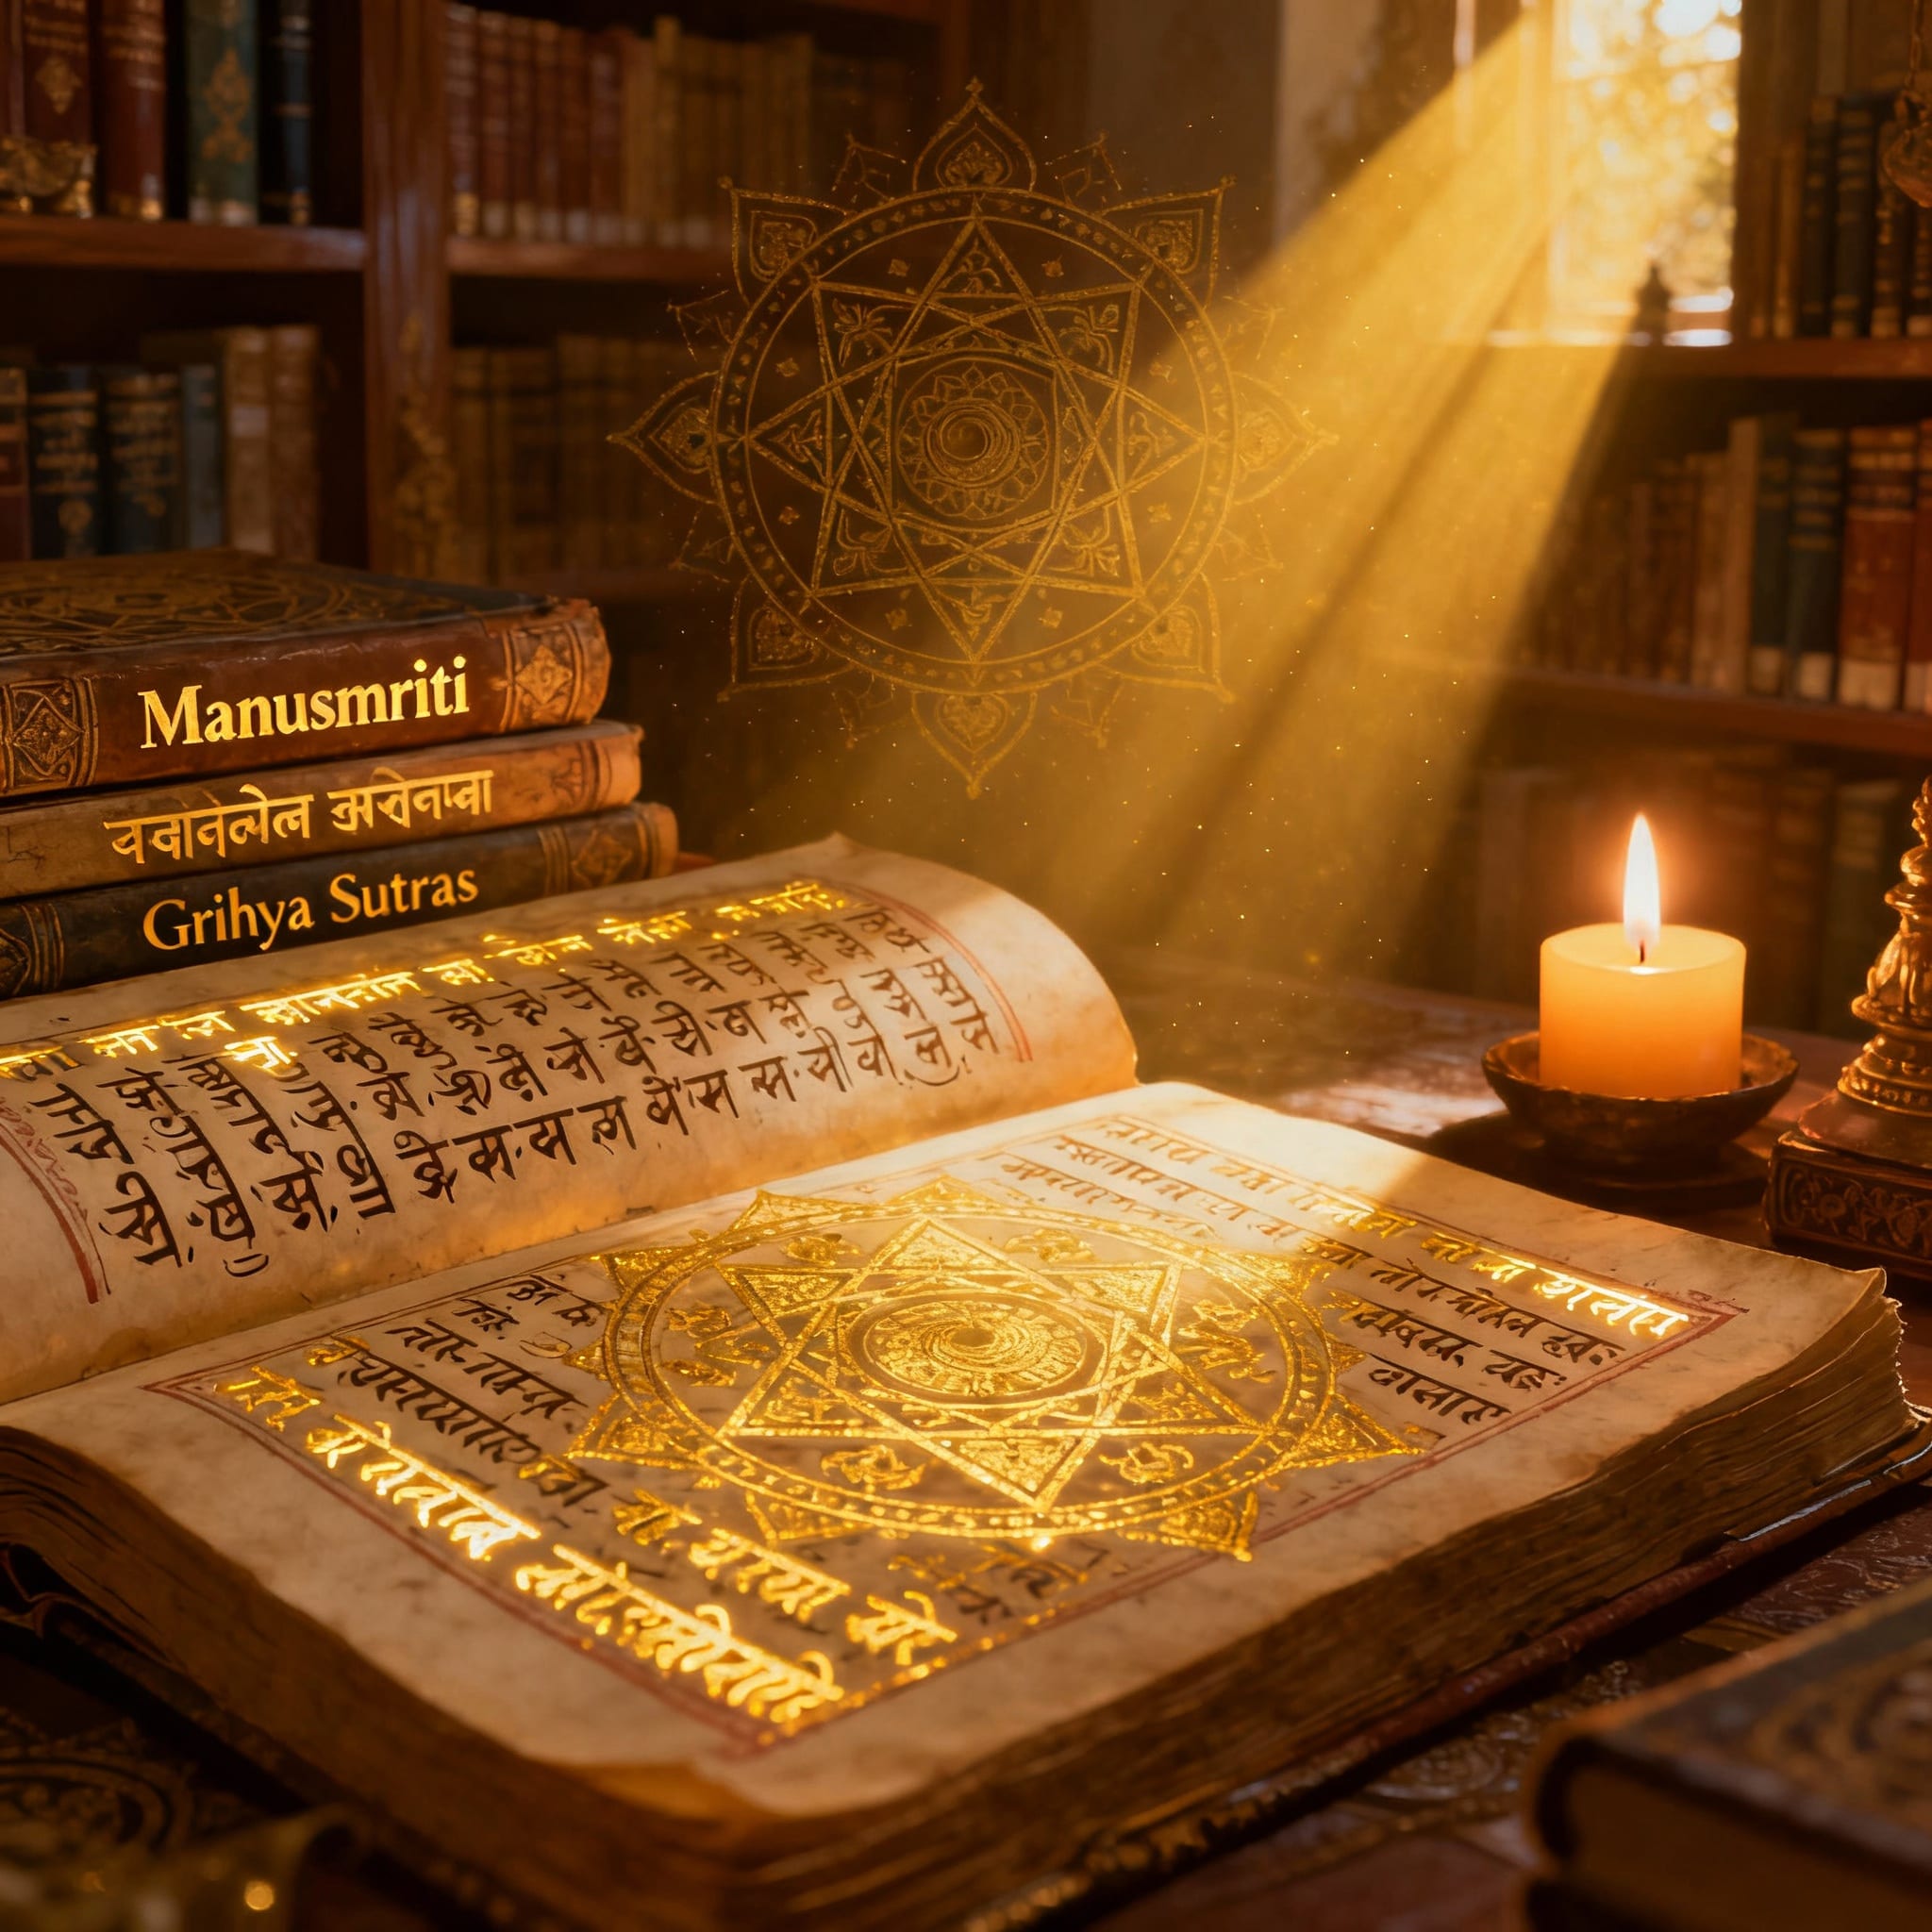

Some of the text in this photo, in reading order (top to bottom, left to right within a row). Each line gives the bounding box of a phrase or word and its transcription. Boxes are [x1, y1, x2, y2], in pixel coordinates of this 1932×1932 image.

[139, 656, 471, 749] Manusmriti
[142, 887, 313, 952] Grihya
[328, 869, 478, 924] Sutras
